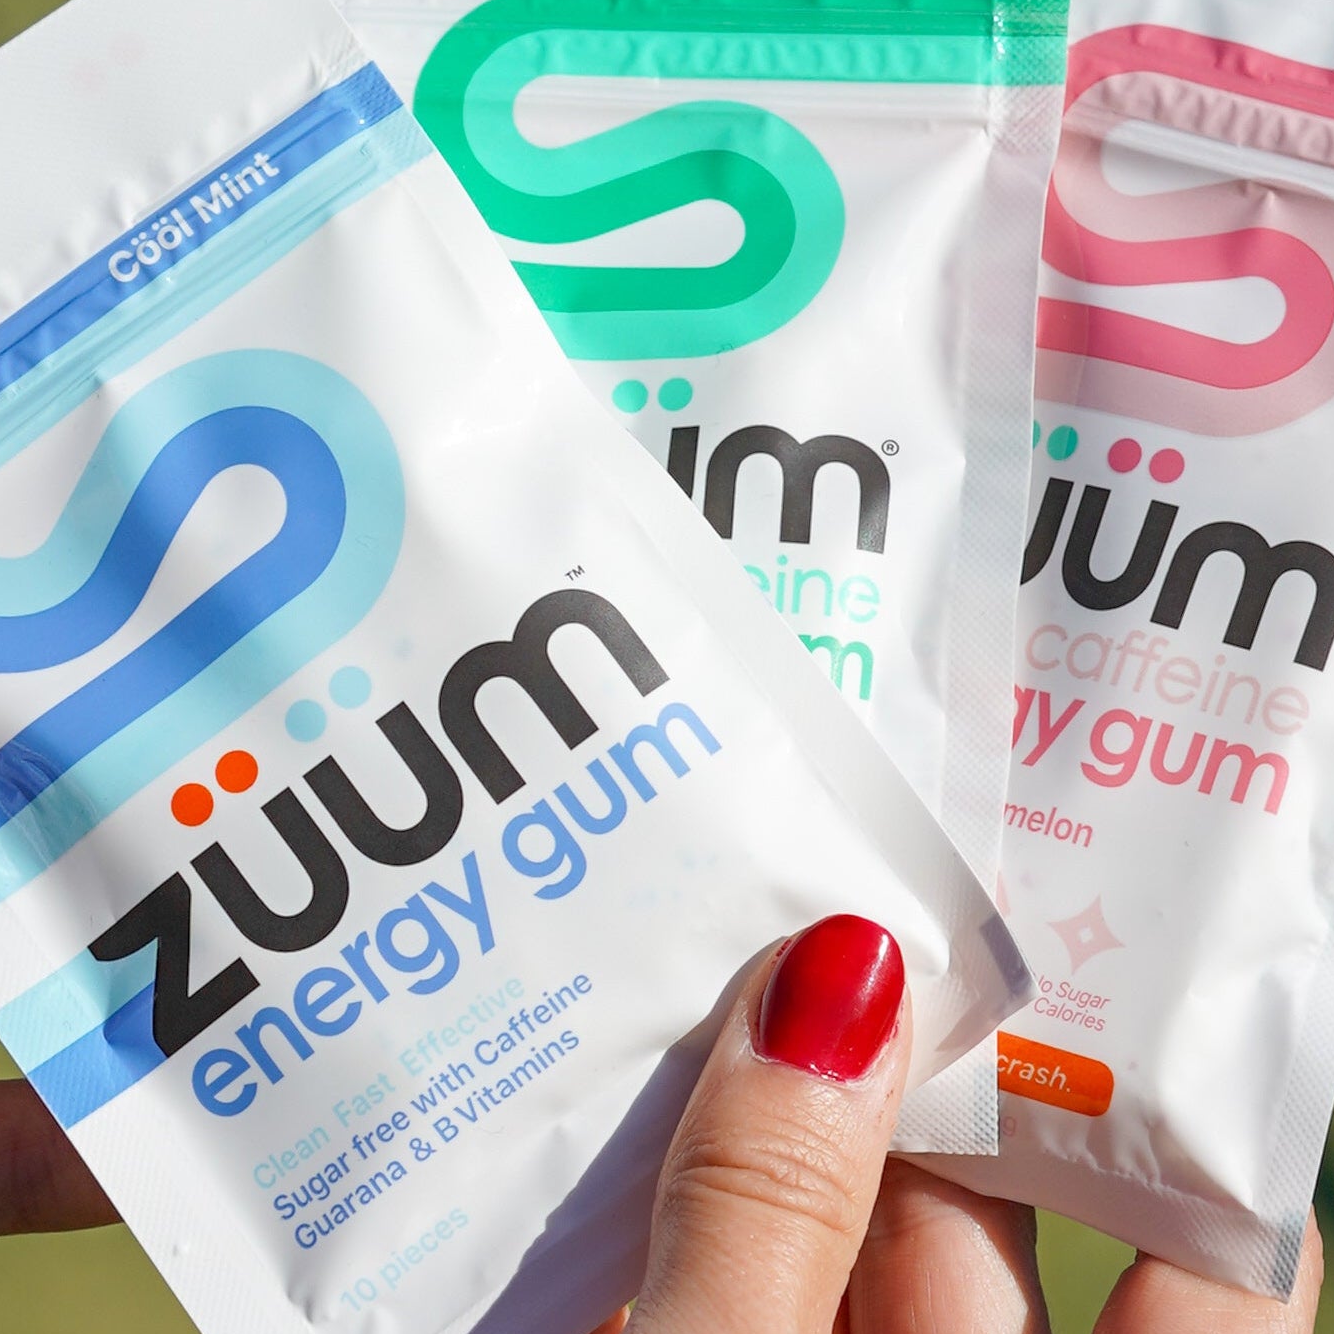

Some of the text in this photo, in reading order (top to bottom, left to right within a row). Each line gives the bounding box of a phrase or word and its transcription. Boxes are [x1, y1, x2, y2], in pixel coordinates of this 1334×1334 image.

[108, 152, 279, 283] Cööl Mint
[1025, 623, 1310, 735] caffeine
[1080, 708, 1289, 815] gum
[88, 589, 670, 1058] züüm
[191, 702, 722, 1117] energy gum
[1034, 997, 1106, 1032] Calories
[1056, 981, 1111, 1010] Sugar
[253, 977, 526, 1190] Clean Fast Effective
[273, 974, 593, 1221] Sugar free with Caffeine
[997, 1054, 1072, 1093] crash.
[295, 1030, 580, 1250] Guarana & B Vitamins
[340, 1207, 470, 1312] 10 pieces
